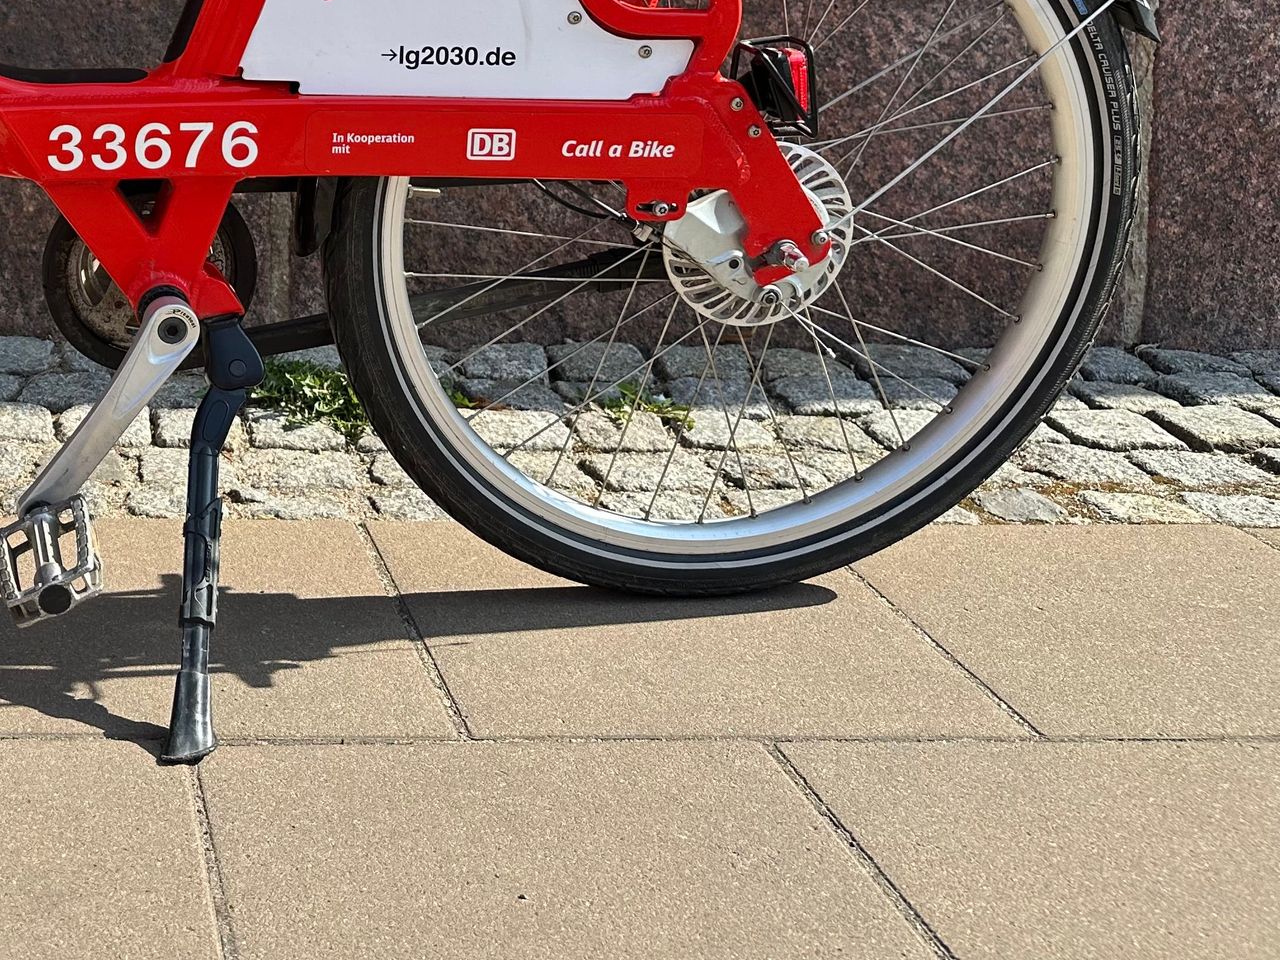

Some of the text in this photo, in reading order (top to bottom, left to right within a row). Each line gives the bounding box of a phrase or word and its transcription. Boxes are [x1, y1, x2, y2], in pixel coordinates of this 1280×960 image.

[399, 46, 517, 70] lg2030.de
[1086, 20, 1103, 50] DELTA
[1099, 53, 1116, 98] CRUISER
[1110, 101, 1121, 131] PLUS
[47, 120, 259, 172] 33676
[331, 144, 351, 154] mit
[332, 132, 415, 145] In Kooperation
[471, 133, 511, 157] DB
[561, 140, 675, 158] Call a Bike
